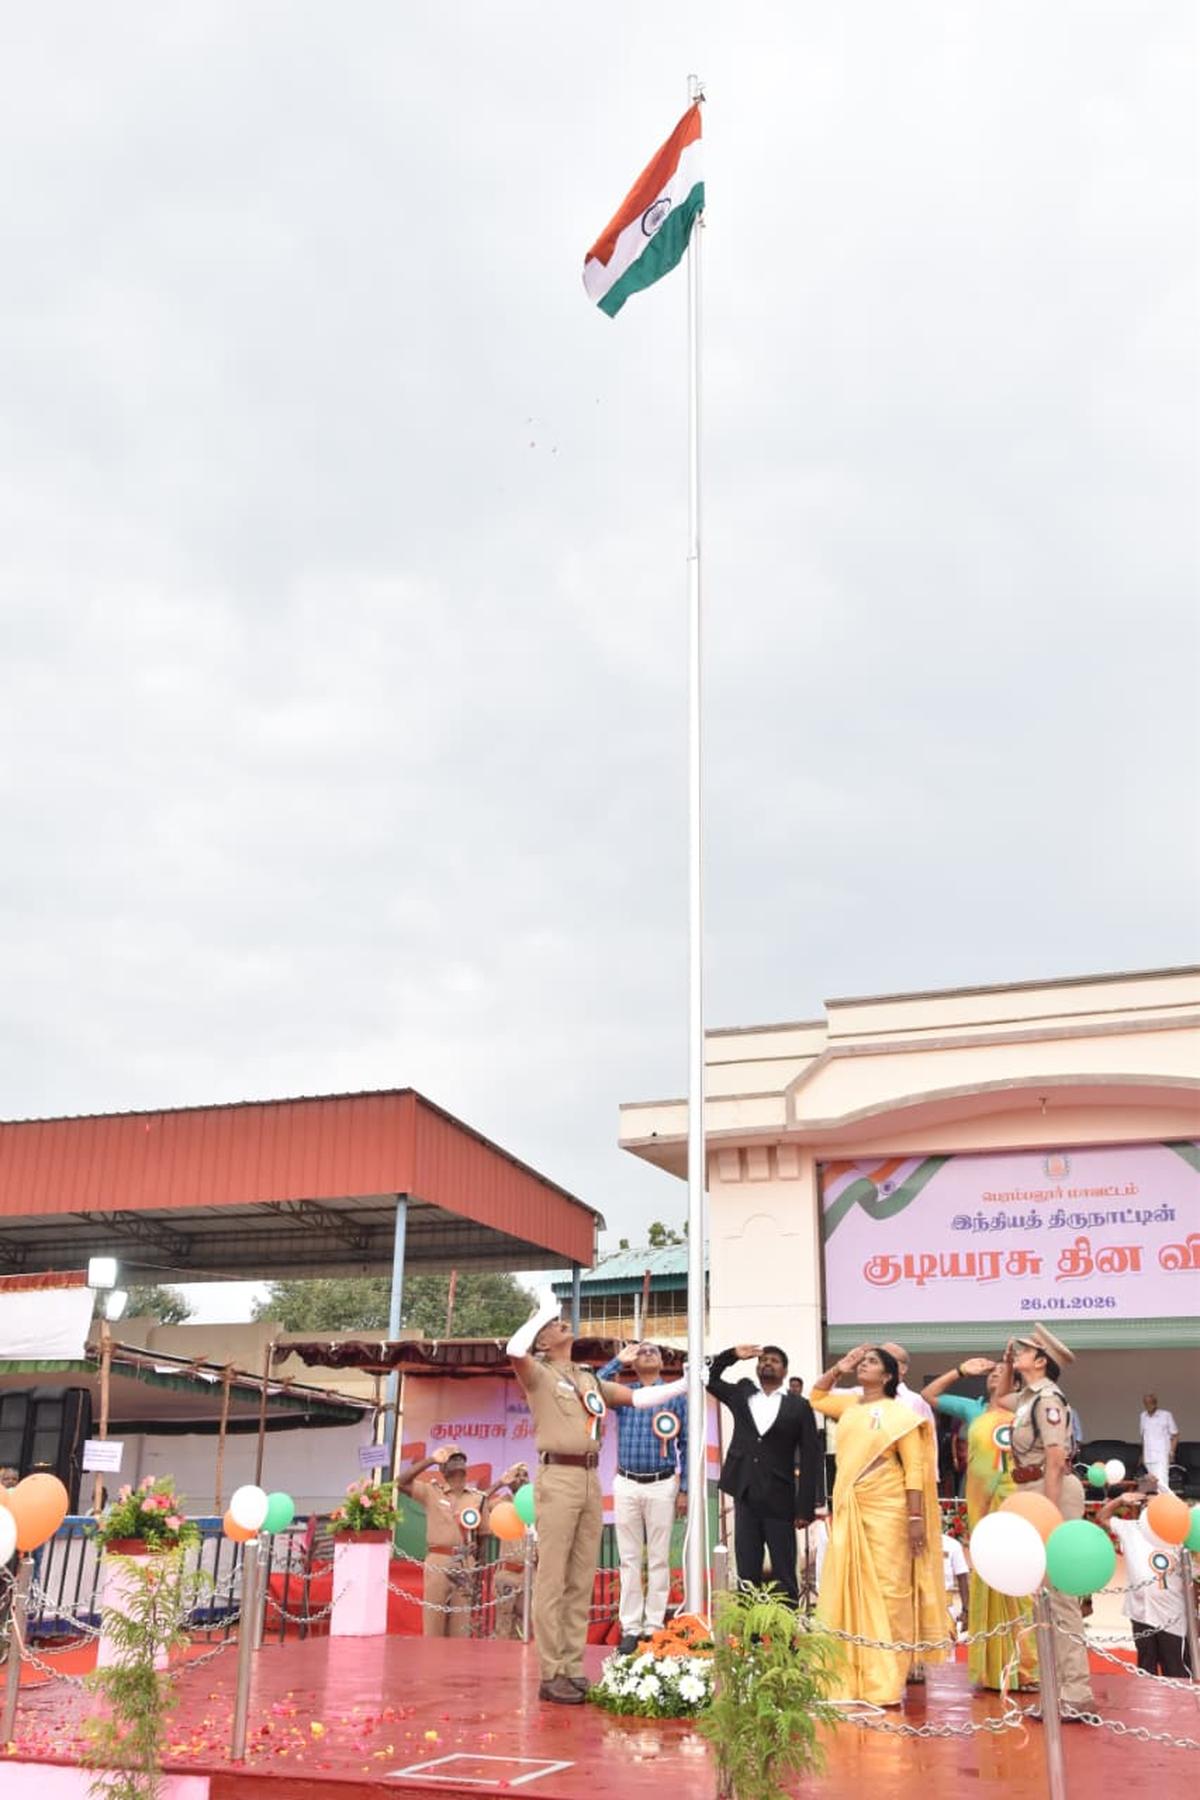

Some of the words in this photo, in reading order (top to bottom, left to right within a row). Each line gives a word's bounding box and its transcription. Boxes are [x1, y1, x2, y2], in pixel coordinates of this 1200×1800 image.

[1068, 1182, 1139, 1198] மாவட்டம்
[951, 1209, 1043, 1233] இந்தியத்
[1048, 1204, 1176, 1230] திருநாட்டின்
[864, 1250, 1043, 1287] குடியரசு
[1055, 1236, 1143, 1282] தின
[1158, 1233, 1200, 1271] வி
[1021, 1296, 1117, 1310] 26.01.2026
[430, 1420, 507, 1441] குடியரசு
